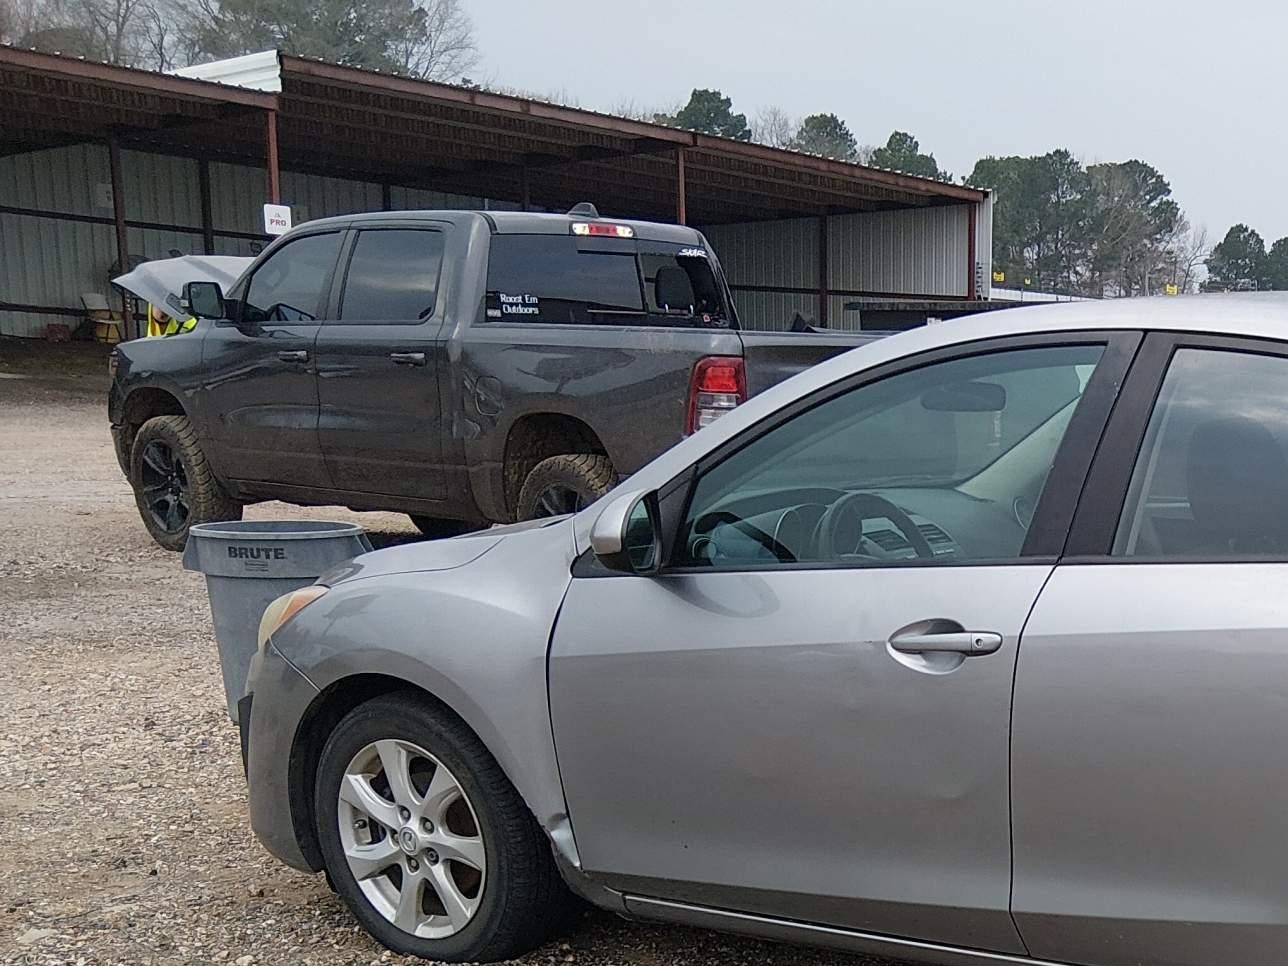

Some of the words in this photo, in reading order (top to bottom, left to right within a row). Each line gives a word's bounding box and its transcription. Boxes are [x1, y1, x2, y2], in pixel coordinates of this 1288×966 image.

[270, 218, 287, 227] PRO
[502, 304, 540, 315] Outdoors
[227, 546, 286, 560] BRUTE
